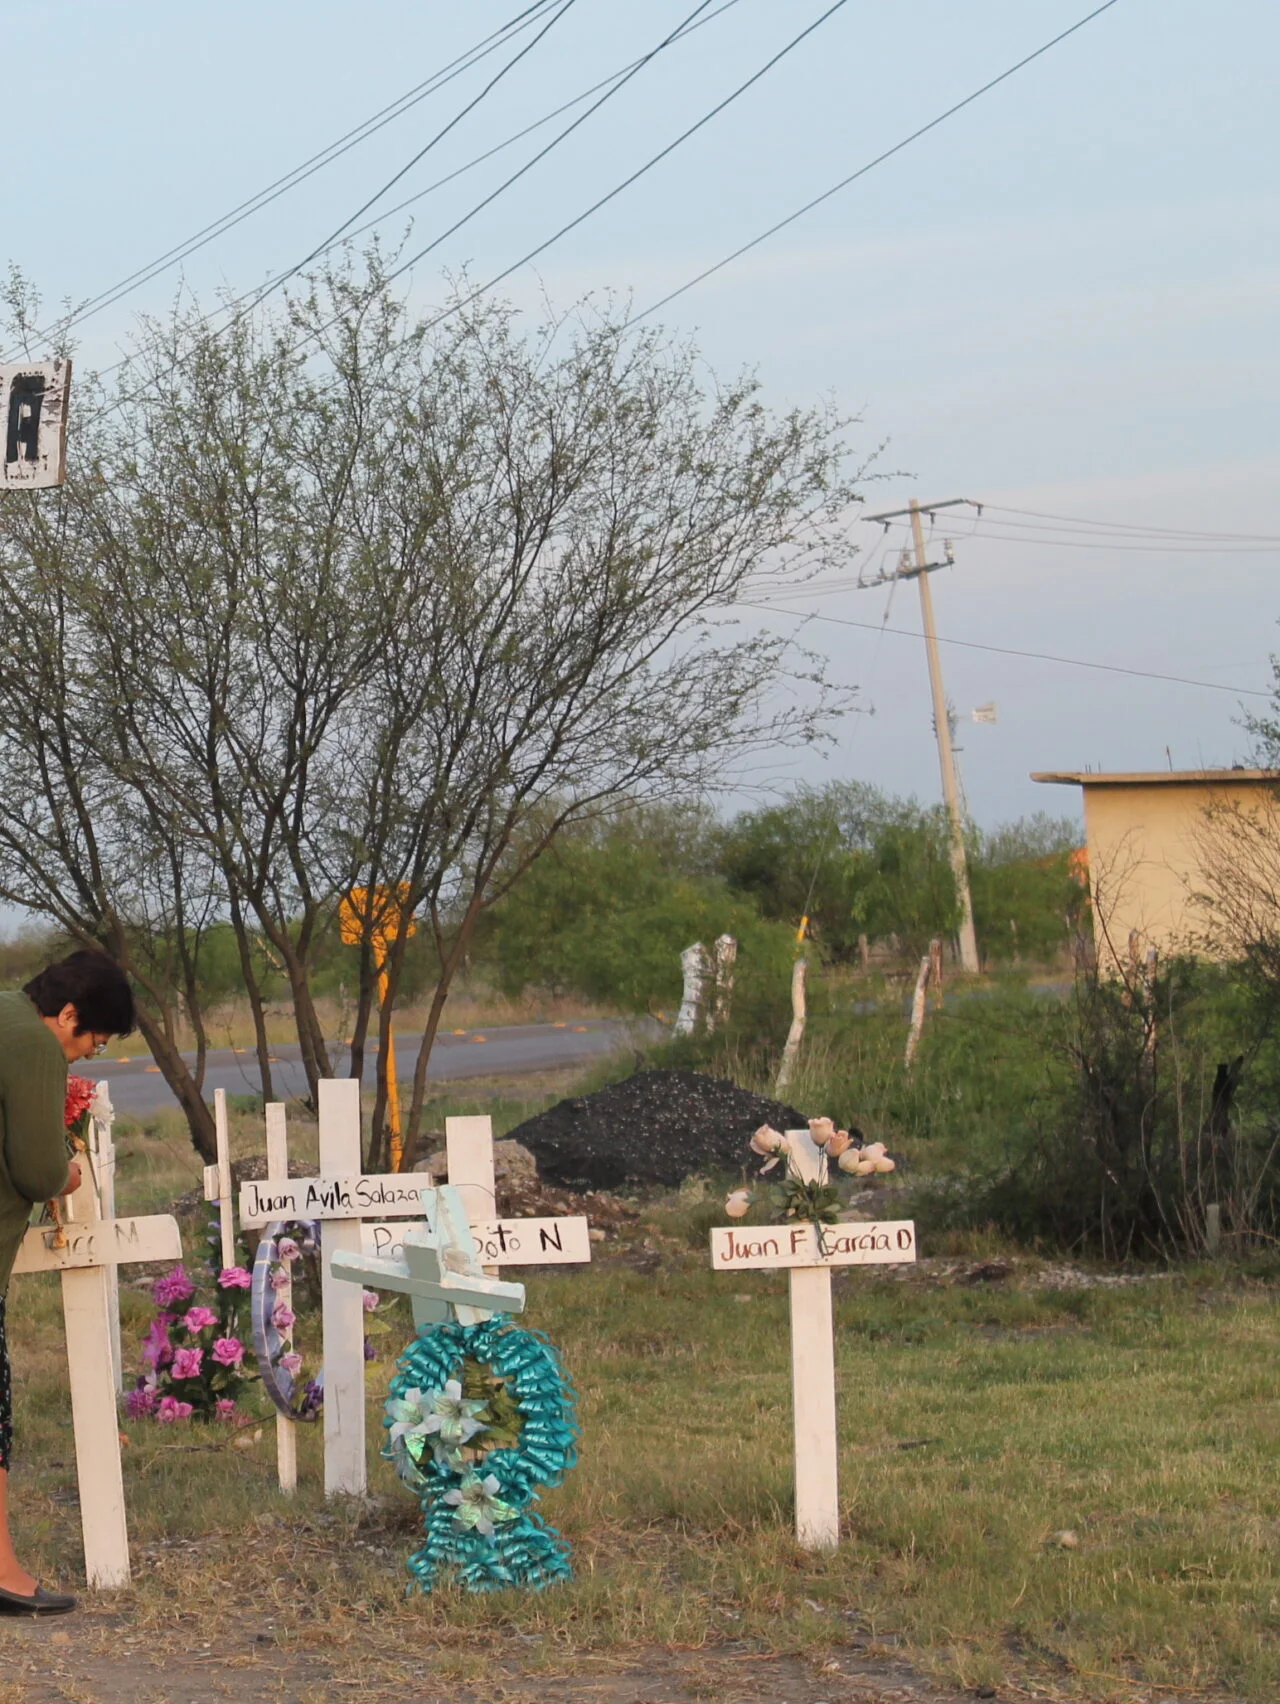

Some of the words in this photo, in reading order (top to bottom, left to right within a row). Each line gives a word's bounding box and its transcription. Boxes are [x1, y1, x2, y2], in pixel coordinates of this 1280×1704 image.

[248, 1184, 296, 1217] Juan
[355, 1179, 419, 1207] Salaza
[539, 1222, 562, 1252] N
[721, 1231, 779, 1262] Juan
[790, 1229, 808, 1254] F
[821, 1226, 892, 1257] García
[897, 1228, 912, 1250] D
